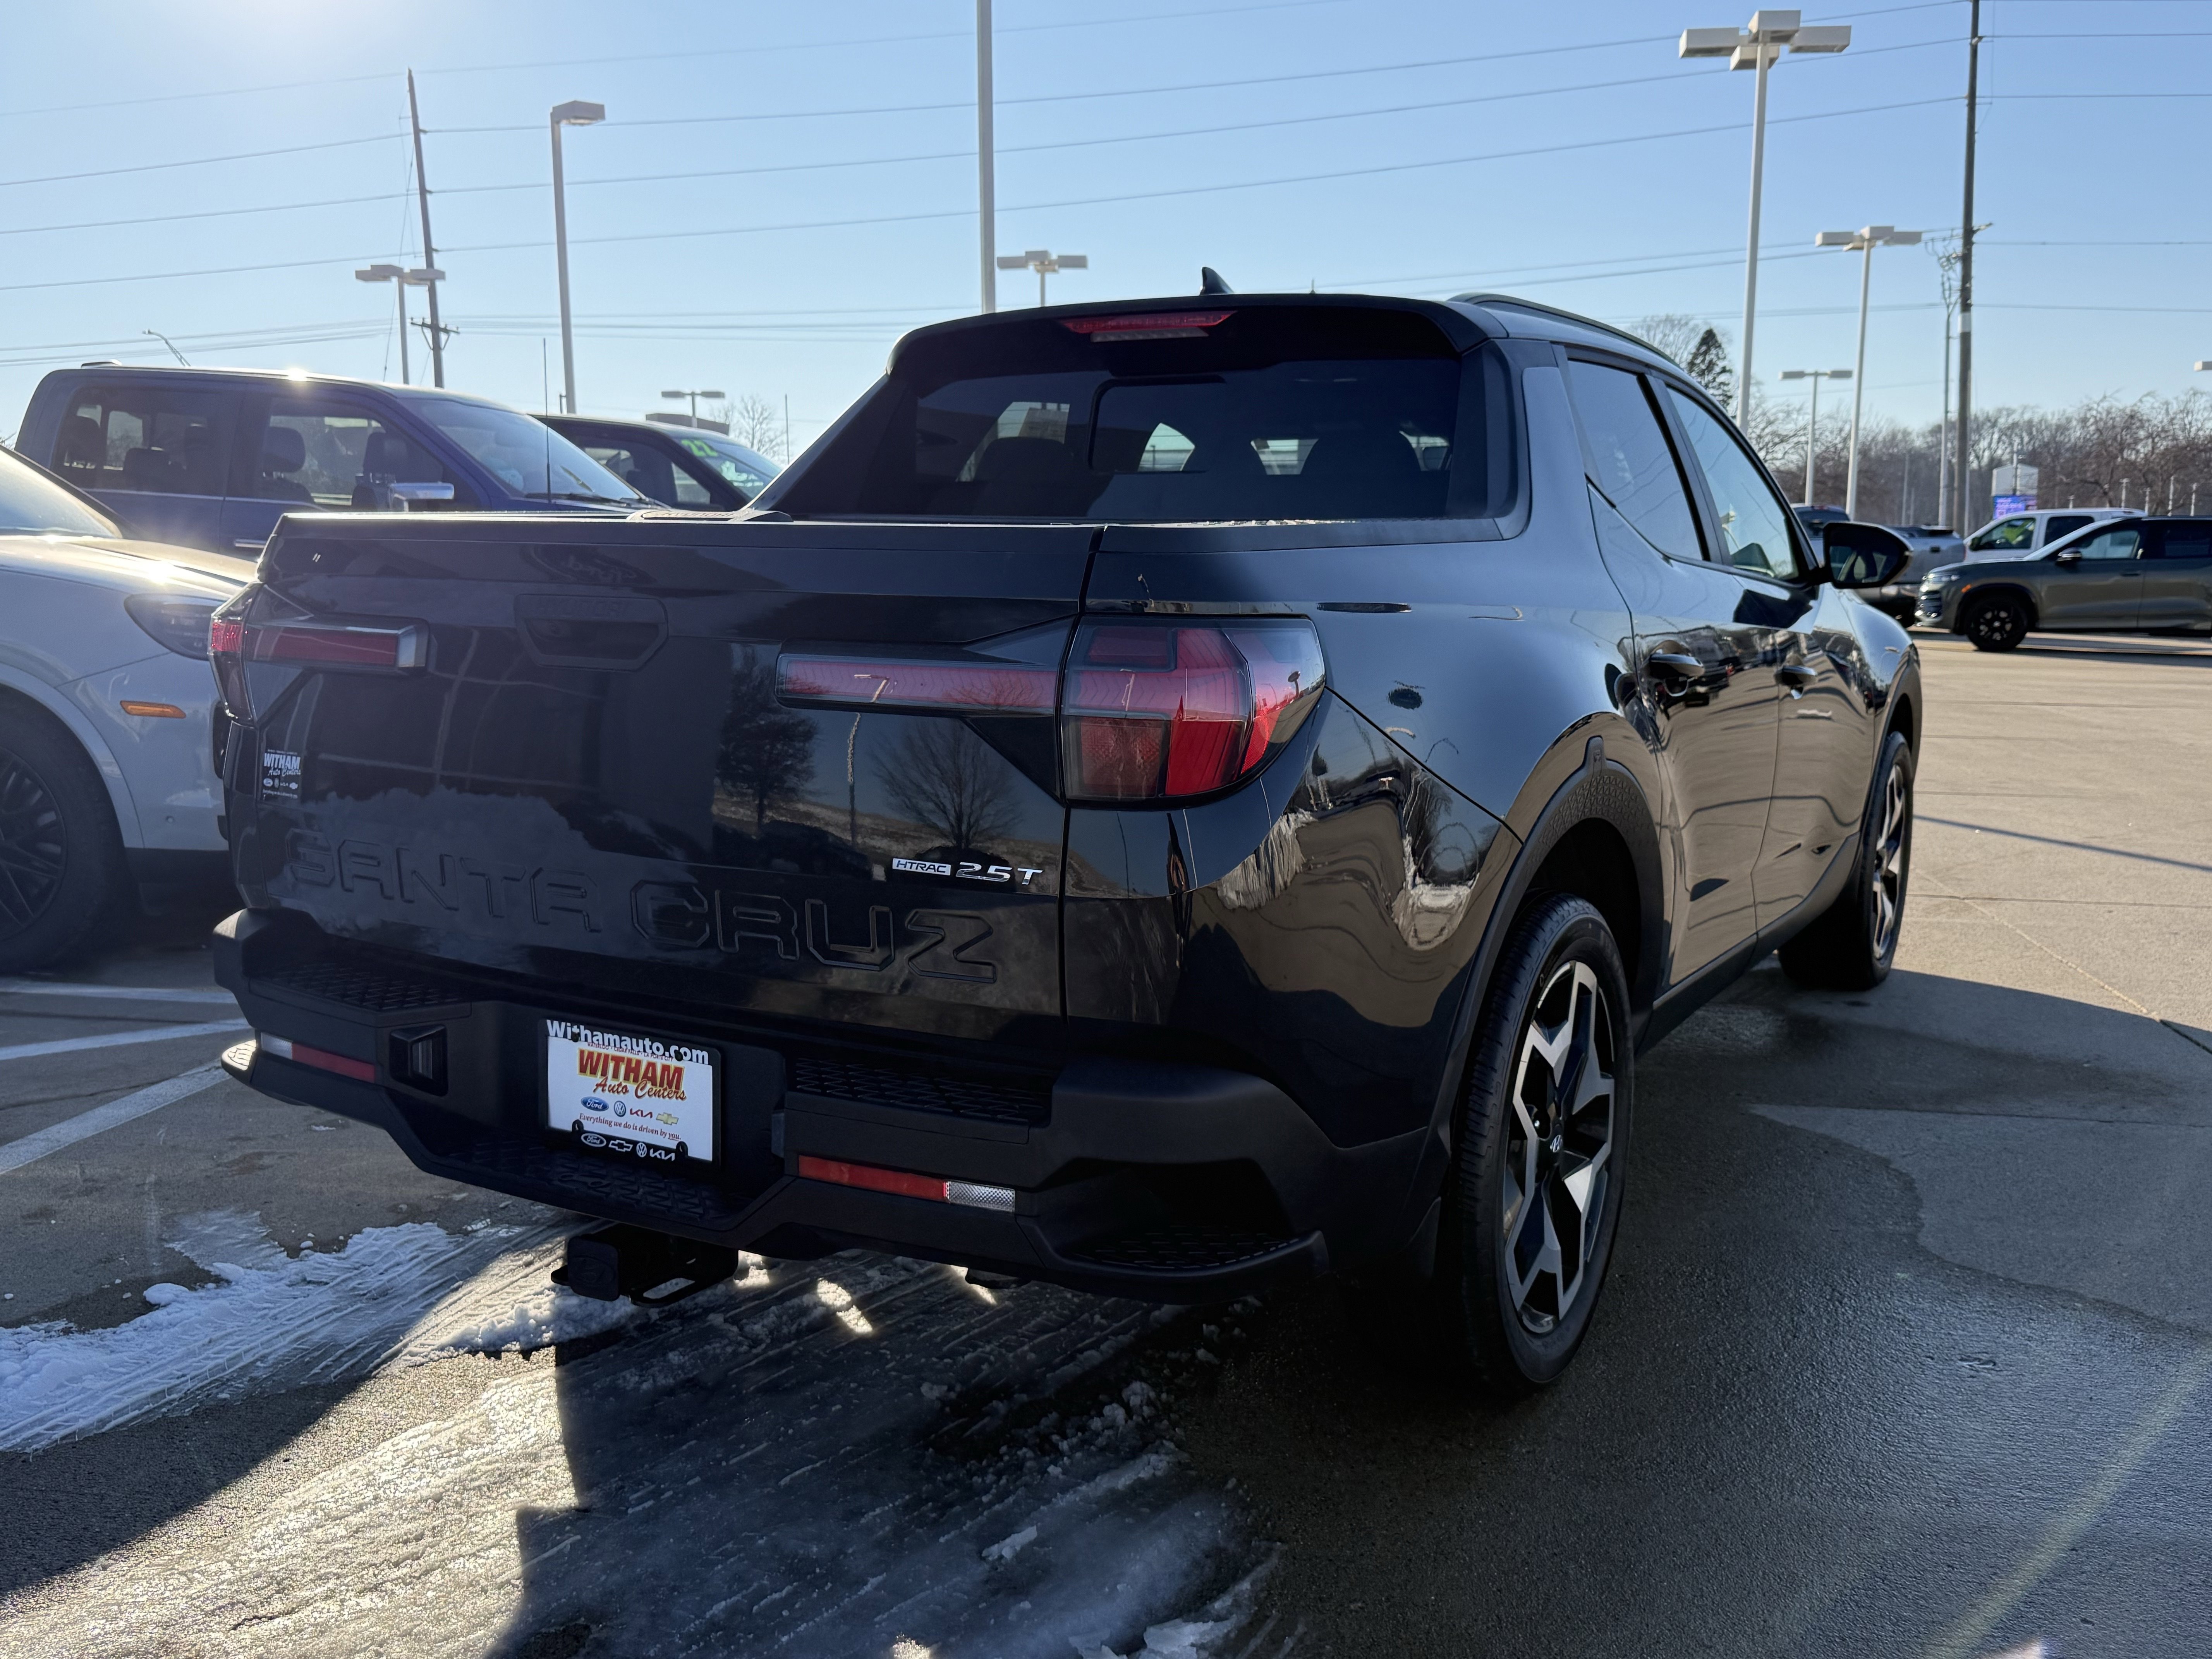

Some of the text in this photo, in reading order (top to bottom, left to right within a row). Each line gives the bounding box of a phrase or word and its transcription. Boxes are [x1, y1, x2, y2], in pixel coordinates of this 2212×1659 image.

[264, 753, 301, 769] WITHAM
[896, 860, 947, 873] HTRAC
[285, 828, 996, 983] SANTA CRUZ
[546, 1019, 708, 1065] Withamauto.com
[579, 1049, 684, 1090] WITHAM
[593, 1076, 687, 1101] Auto Centers
[580, 1113, 612, 1128] Everything
[639, 1125, 658, 1135] driven
[660, 1129, 667, 1139] by
